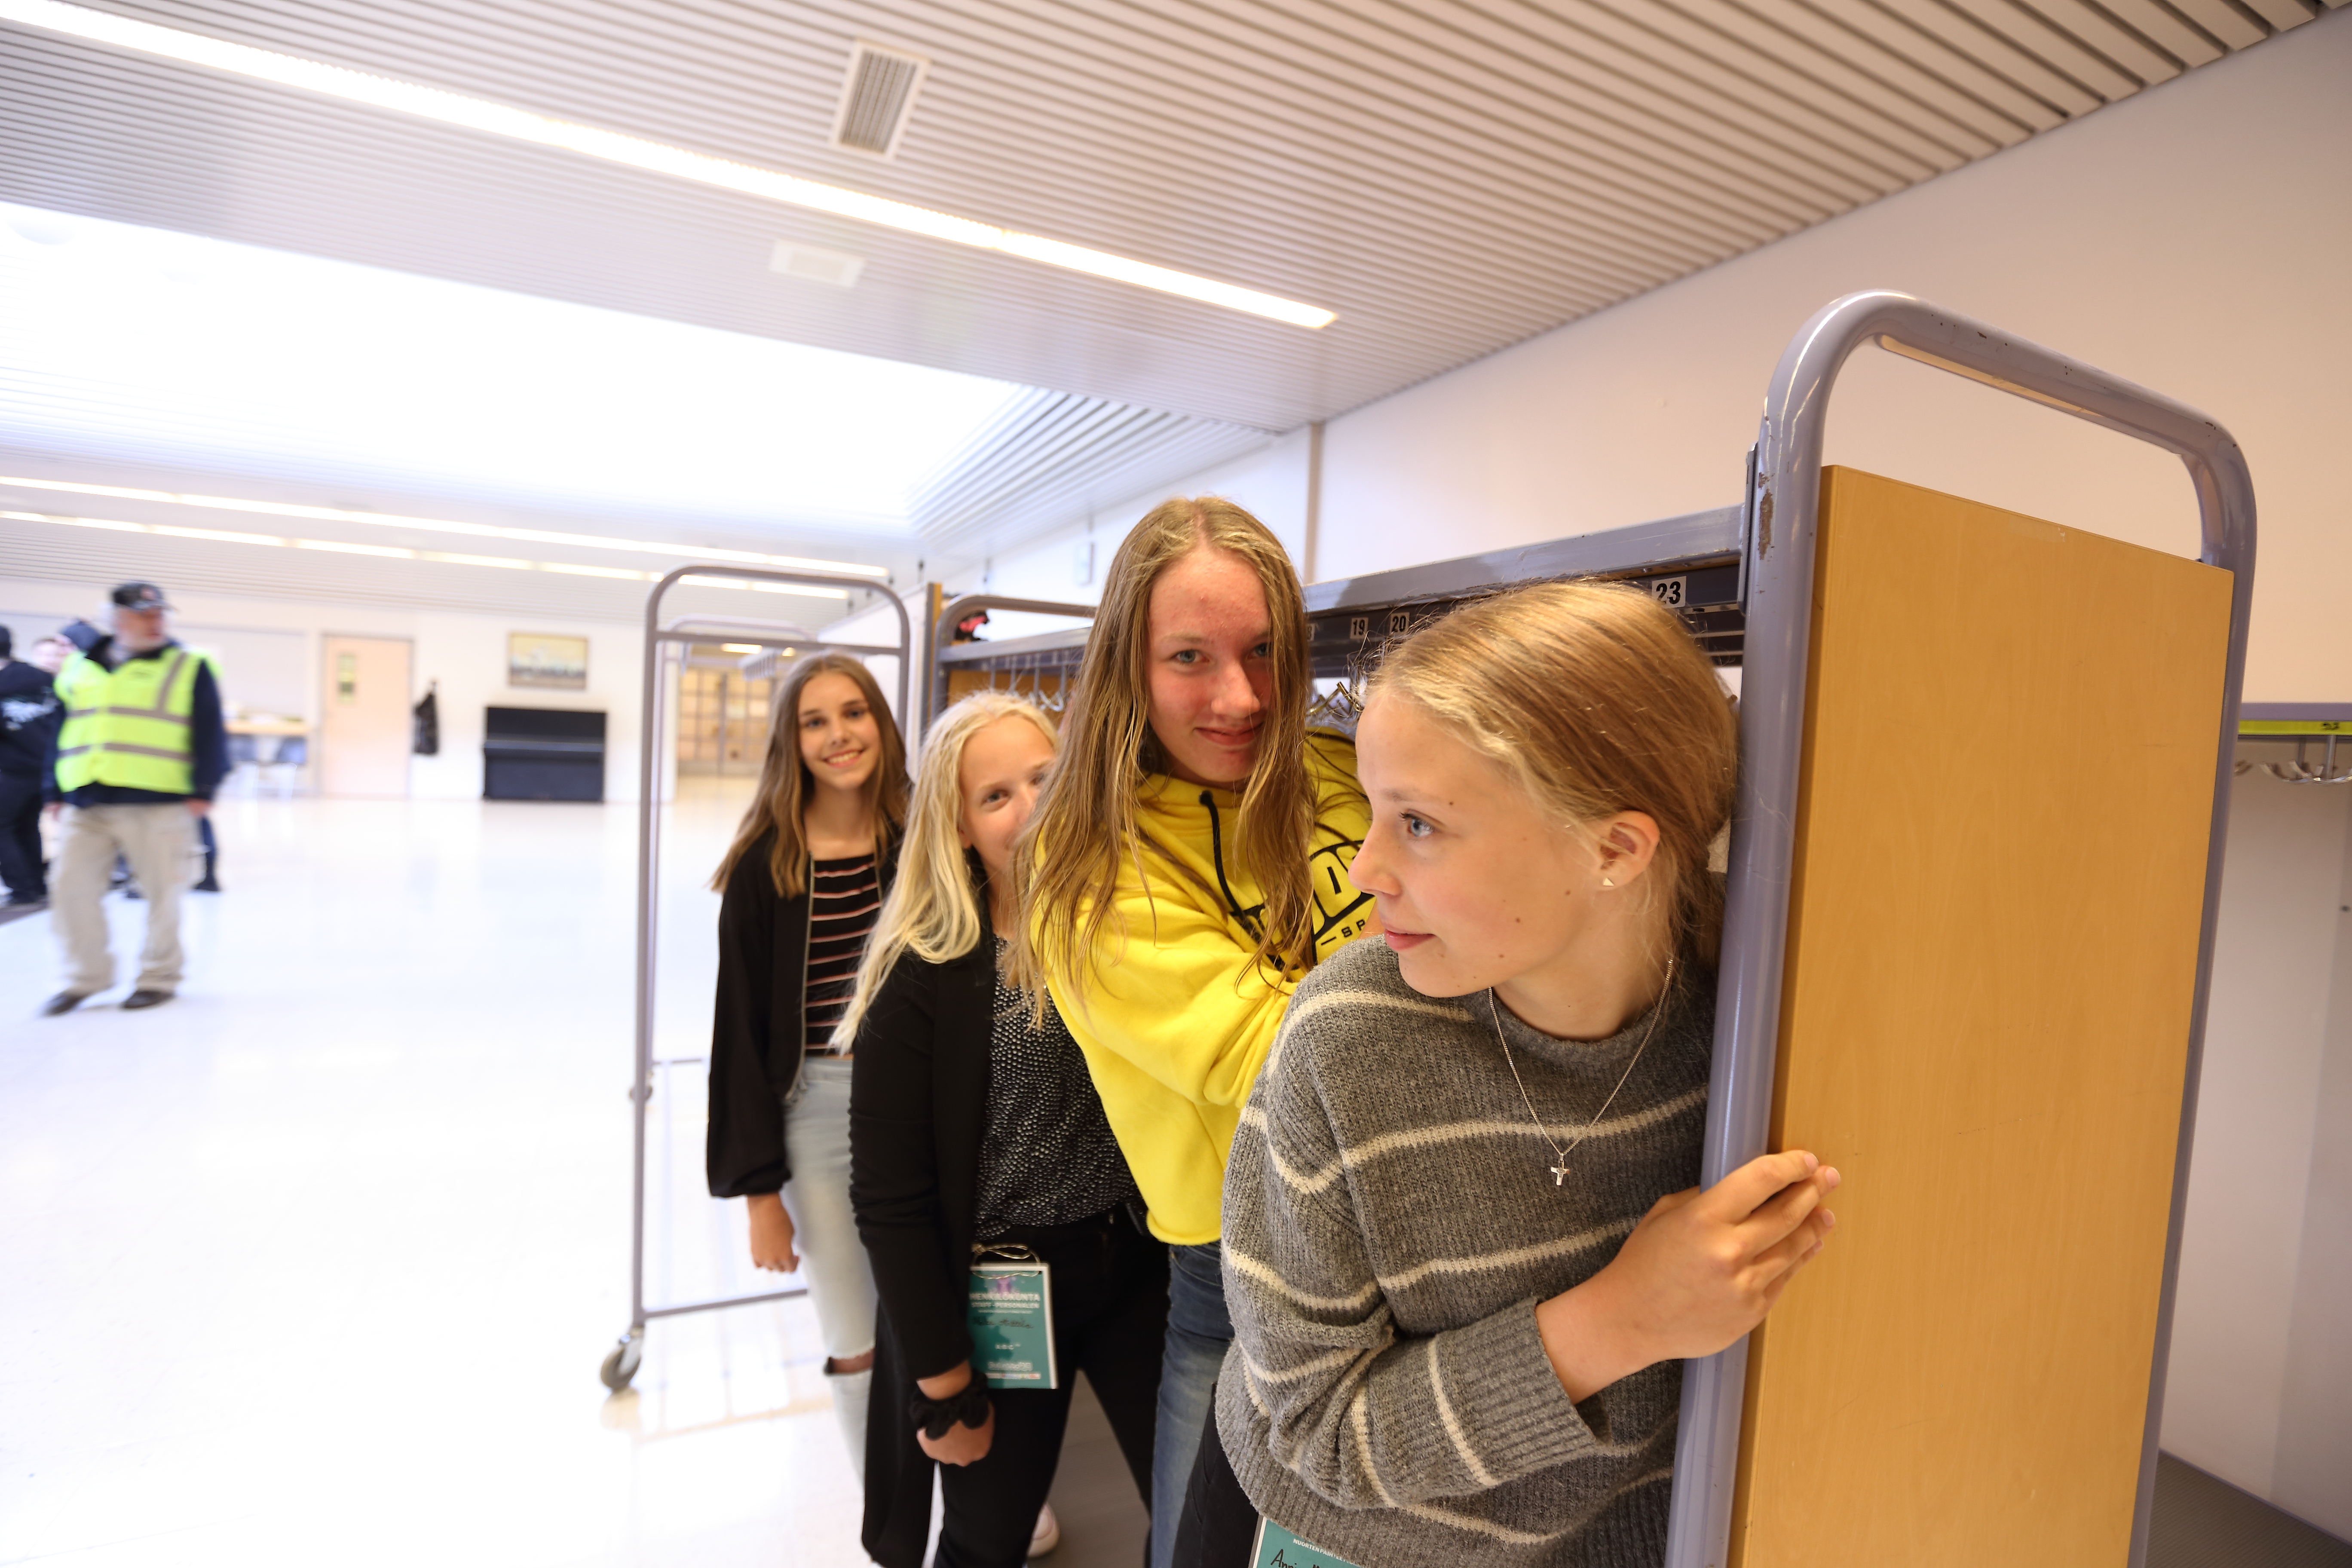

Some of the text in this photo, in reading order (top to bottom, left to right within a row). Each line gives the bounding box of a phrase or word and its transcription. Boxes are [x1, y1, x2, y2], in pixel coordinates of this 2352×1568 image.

[1656, 581, 1681, 604] 23
[1353, 620, 1366, 636] 19
[1392, 616, 1407, 632] 20
